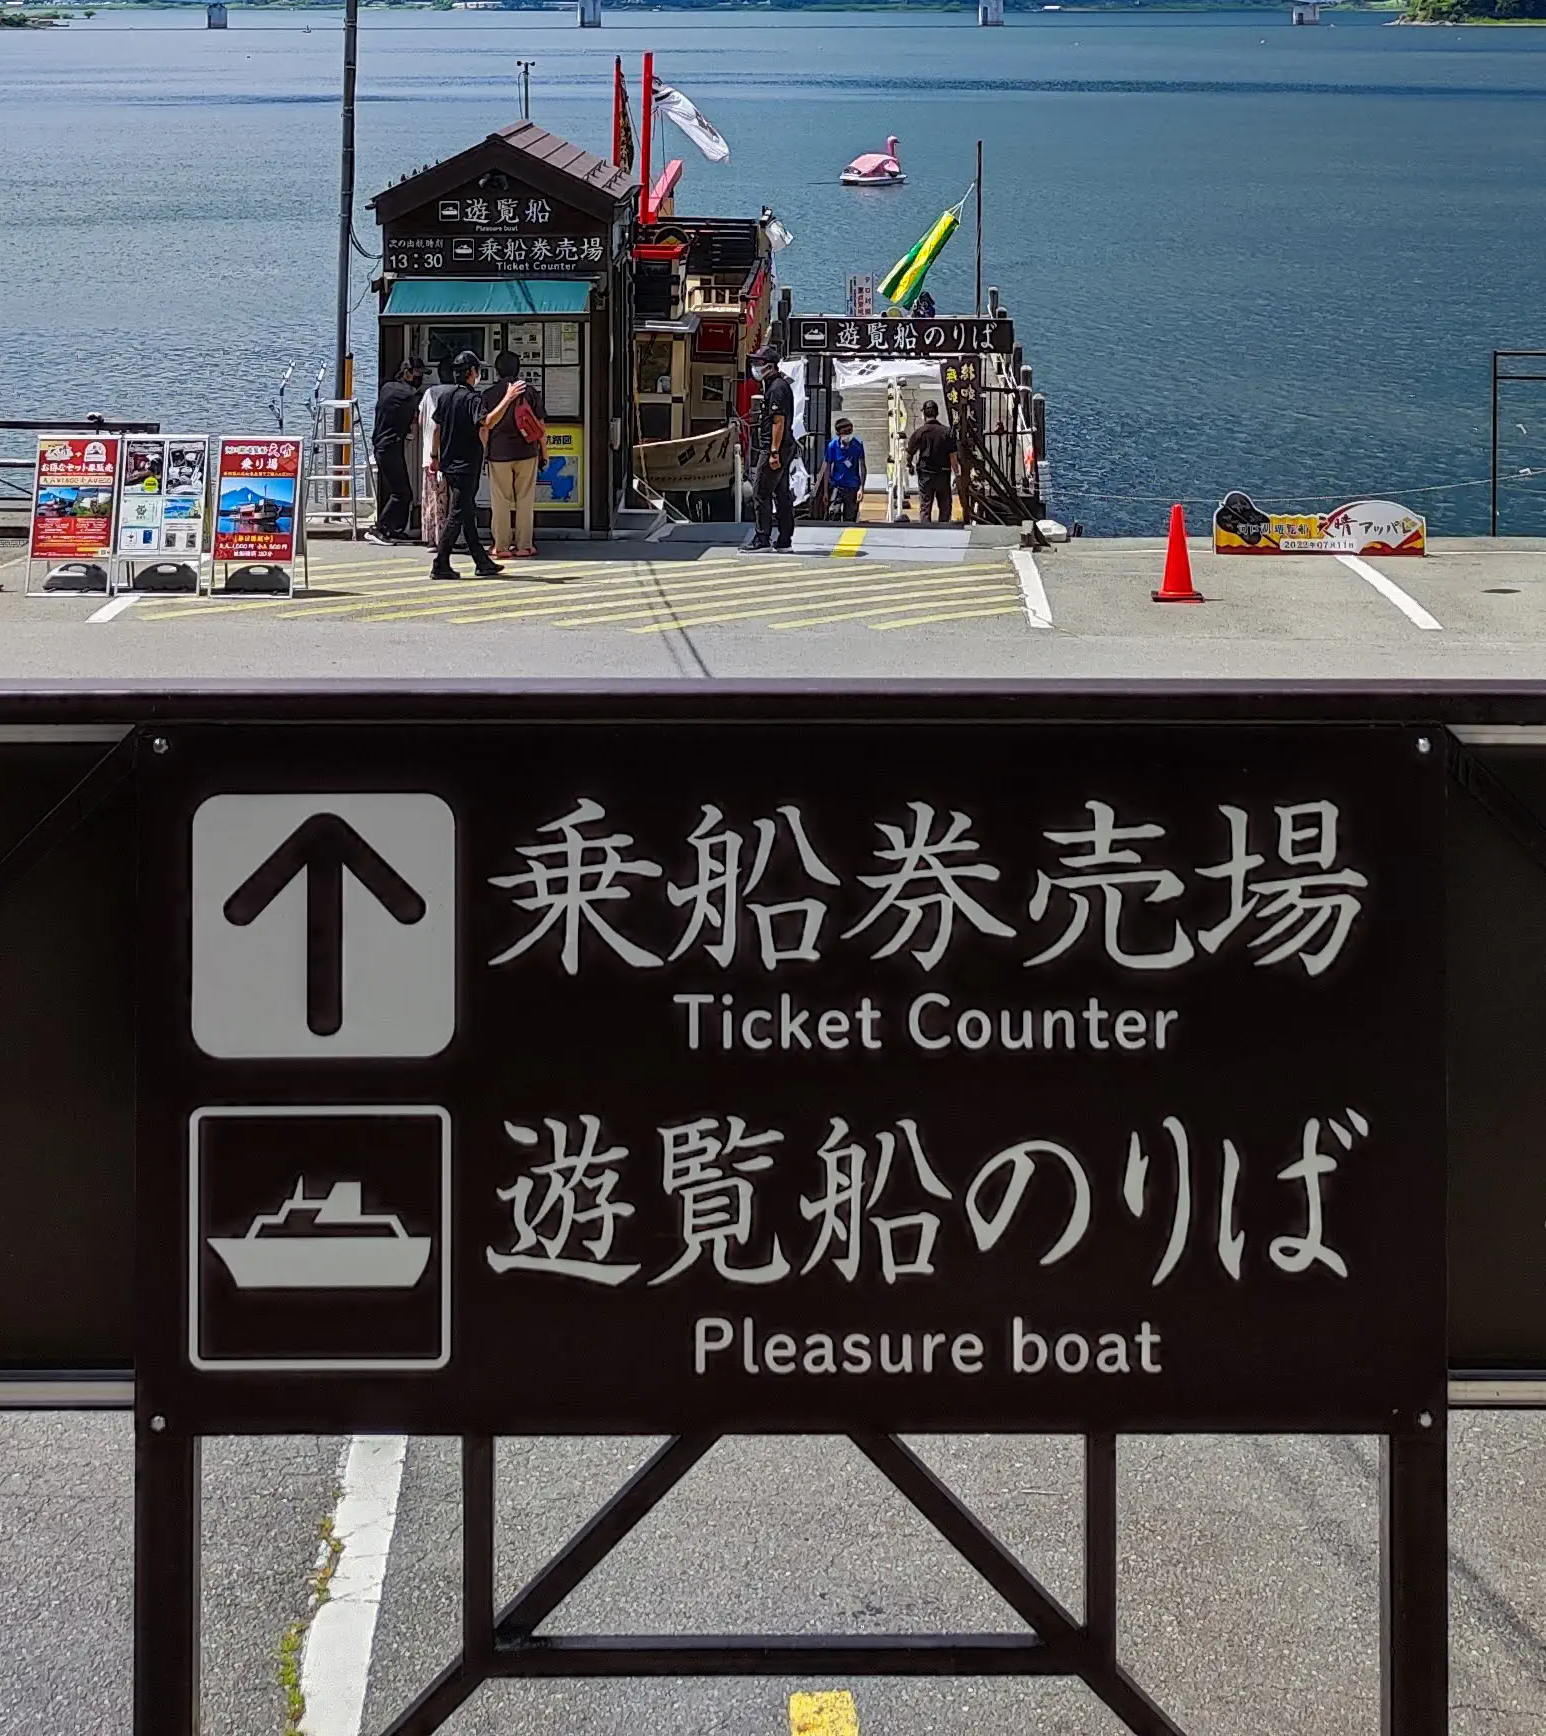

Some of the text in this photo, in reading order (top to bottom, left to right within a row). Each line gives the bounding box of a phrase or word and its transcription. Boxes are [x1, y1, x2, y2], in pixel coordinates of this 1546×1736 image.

[463, 198, 551, 224] 遊覧船
[477, 237, 604, 262] 乗船券売場
[496, 262, 577, 271] Ticket Counter
[835, 321, 998, 351] 遊覧船のりば
[240, 457, 278, 470] 乗り場
[487, 798, 1368, 976] 乗船券売場
[672, 992, 1179, 1050] Ticket Counter
[486, 1107, 1369, 1286] 遊覧船のりば
[694, 1317, 1162, 1374] Pleasure boat
